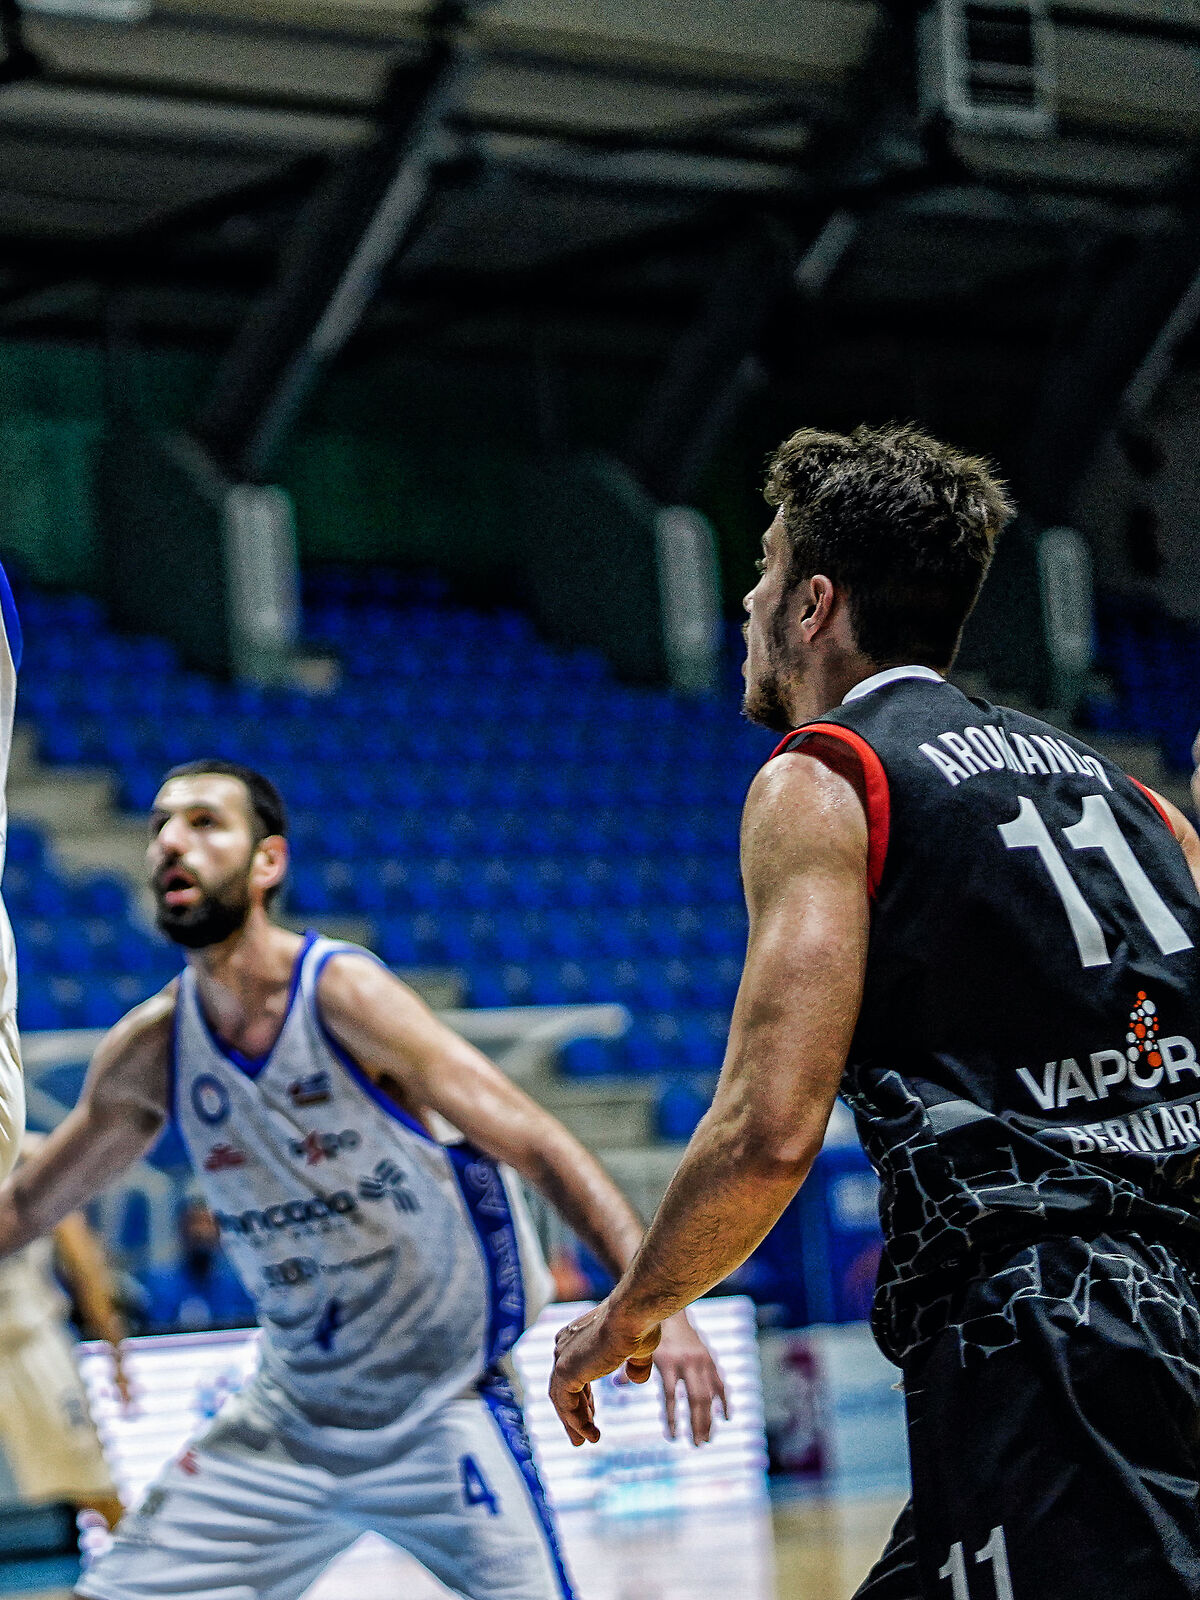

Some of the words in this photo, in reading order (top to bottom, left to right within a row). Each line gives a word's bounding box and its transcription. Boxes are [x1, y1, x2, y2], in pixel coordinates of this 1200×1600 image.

[997, 795, 1195, 968] 11
[1060, 1100, 1200, 1155] BERNAR
[459, 1453, 502, 1517] 4
[939, 1525, 1015, 1600] 11
